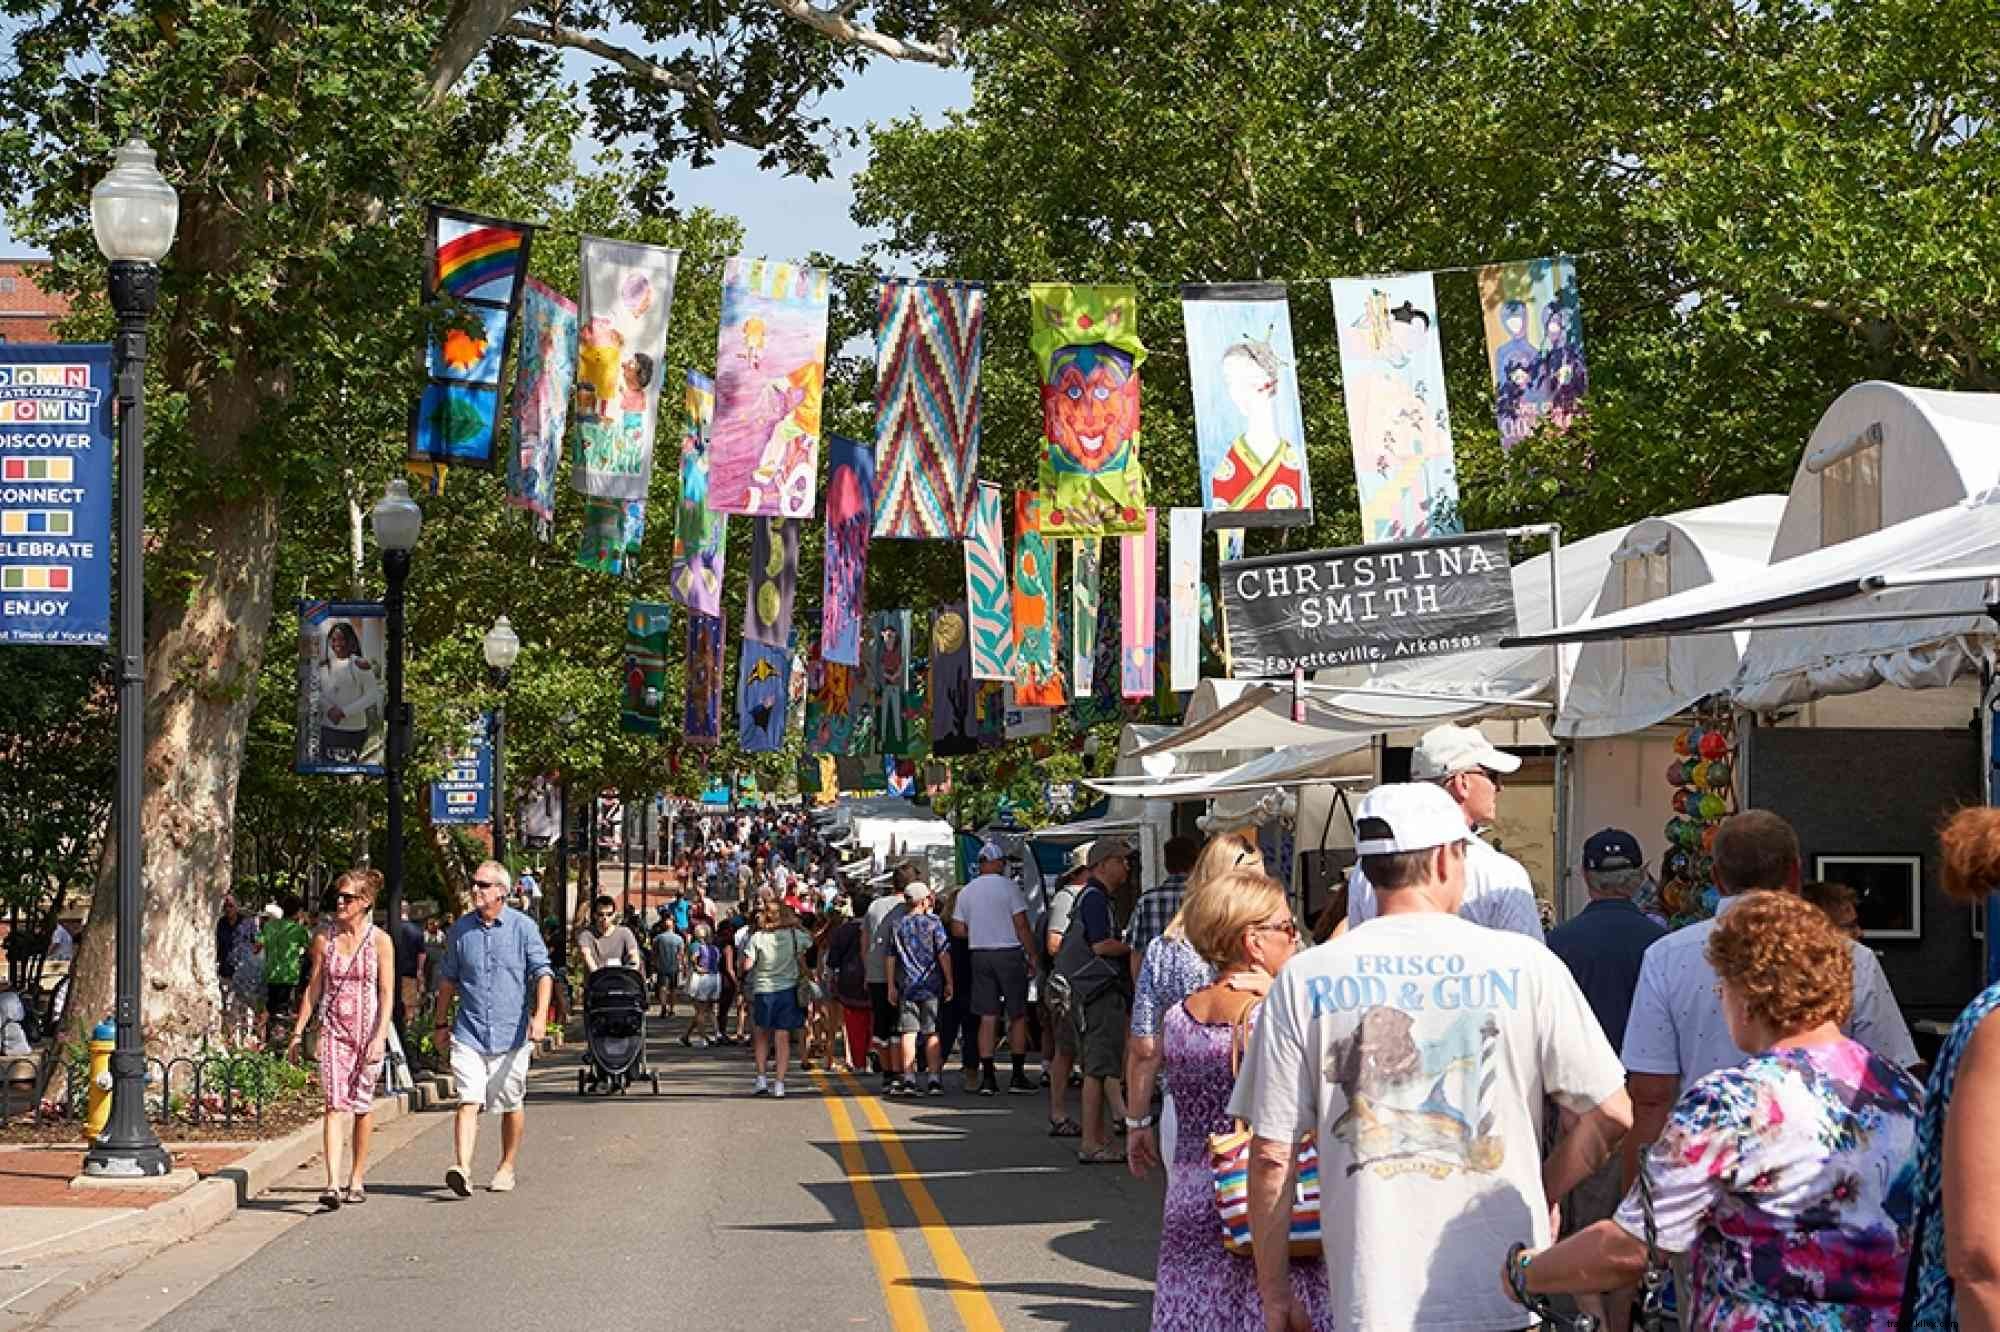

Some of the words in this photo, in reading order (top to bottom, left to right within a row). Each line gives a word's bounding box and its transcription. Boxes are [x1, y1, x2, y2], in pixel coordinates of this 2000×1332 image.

[0, 488, 85, 503] ONNECT
[1236, 544, 1494, 600] CHRISTINA
[5, 600, 69, 616] ENJOY
[1301, 585, 1441, 628] SMITH
[48, 631, 59, 640] of
[62, 631, 85, 640] Your
[1265, 644, 1386, 672] Fayetteville,
[1395, 633, 1481, 655] Arkansas
[1355, 954, 1465, 976] FRISCO
[1305, 974, 1388, 1017] ROD
[1400, 982, 1425, 1010] &
[1432, 969, 1521, 1010] GUN
